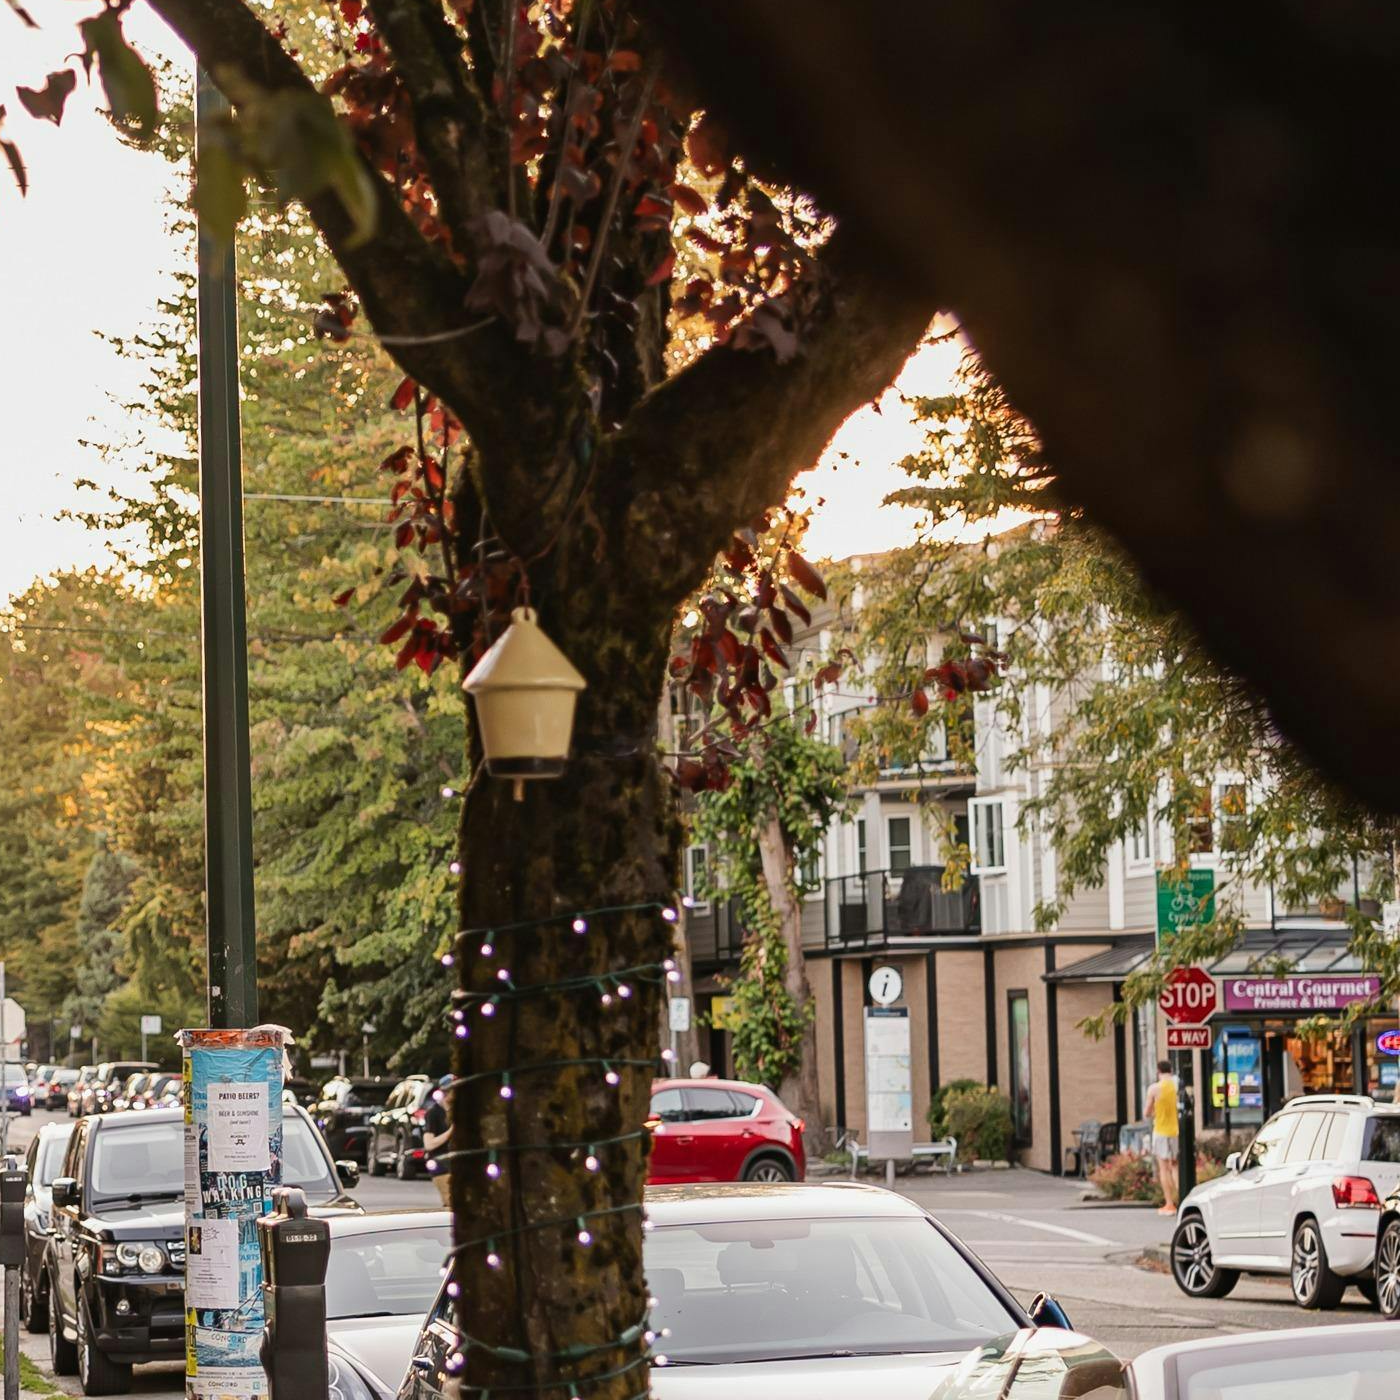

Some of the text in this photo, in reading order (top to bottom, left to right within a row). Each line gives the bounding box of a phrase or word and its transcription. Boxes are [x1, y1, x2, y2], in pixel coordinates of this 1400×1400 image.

[1159, 982, 1216, 1009] STOP
[1232, 978, 1373, 998] Central Gourmet
[1253, 995, 1337, 1009] Produce & Deli
[1169, 1031, 1208, 1045] 4 WAY
[218, 1092, 237, 1100] PATIO
[217, 1173, 248, 1190] DOG
[202, 1186, 262, 1204] WALKING
[211, 1333, 248, 1343] CONCORD
